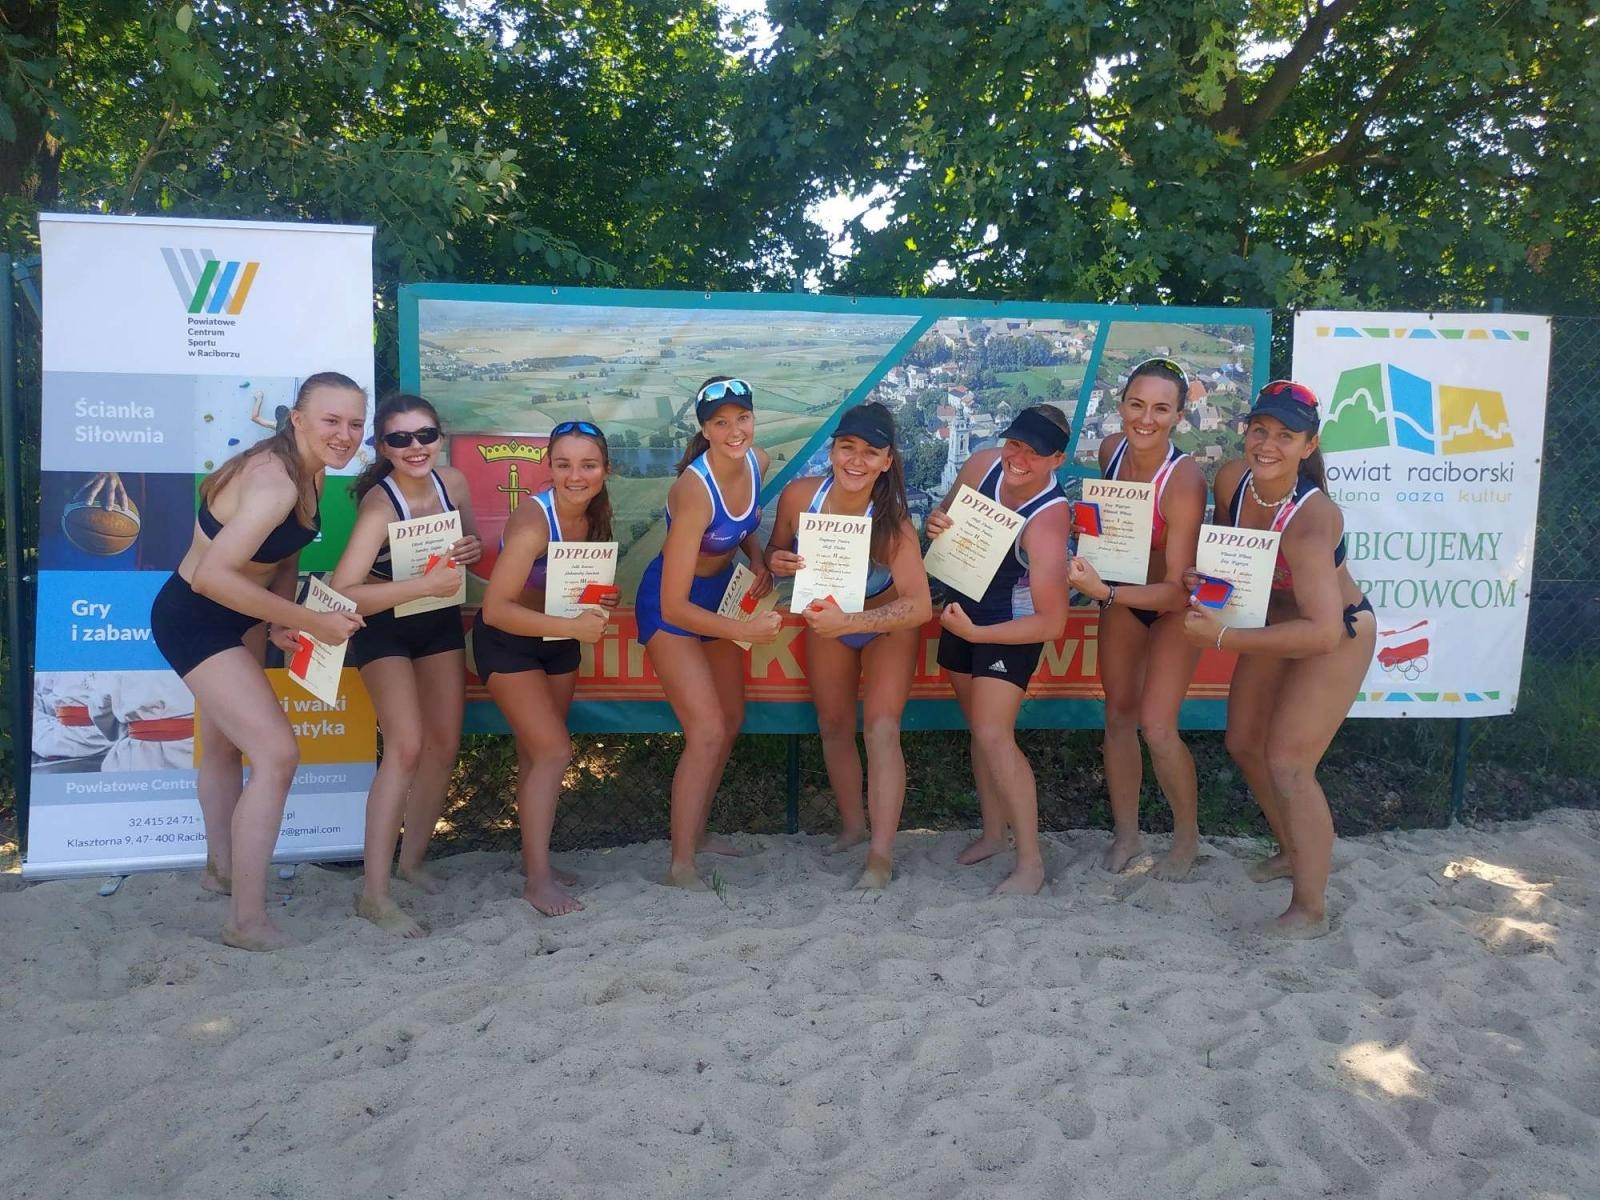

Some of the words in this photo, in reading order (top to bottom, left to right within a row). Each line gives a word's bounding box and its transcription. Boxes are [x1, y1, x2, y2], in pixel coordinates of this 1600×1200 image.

[187, 317, 236, 326] Powiatowe
[187, 328, 225, 336] Centrum
[188, 339, 217, 347] Sportu
[197, 350, 240, 358] Raciborzu
[75, 397, 155, 418] Ścianka
[75, 425, 164, 443] Siłownia
[1326, 460, 1392, 482] owiat
[1407, 461, 1514, 482] raciborski
[1089, 485, 1150, 501] DYPLOM
[1329, 487, 1380, 502] elona
[1396, 491, 1444, 503] oaza
[961, 494, 1018, 530] DYPLOM
[396, 518, 455, 540] DYPLOM
[805, 519, 866, 535] DYPLOM
[1206, 532, 1275, 551] DYPLOM
[1344, 531, 1503, 568] IBICUJEMY
[554, 548, 614, 560] DYPLOM
[720, 568, 744, 614] YPLOM
[1357, 579, 1518, 609] TOWCOM
[71, 599, 112, 620] Gry
[71, 623, 78, 641] i
[82, 623, 156, 644] zabaw
[291, 719, 345, 740] atyka
[65, 781, 148, 794] Powiatowe
[152, 777, 199, 791] Centru
[292, 771, 348, 785] ciborzu
[128, 817, 143, 828] 32
[144, 816, 164, 826] 415
[166, 815, 179, 826] 24
[181, 815, 194, 825] 71
[280, 825, 341, 837] z@gmail.com
[68, 837, 122, 848] Klasztorna
